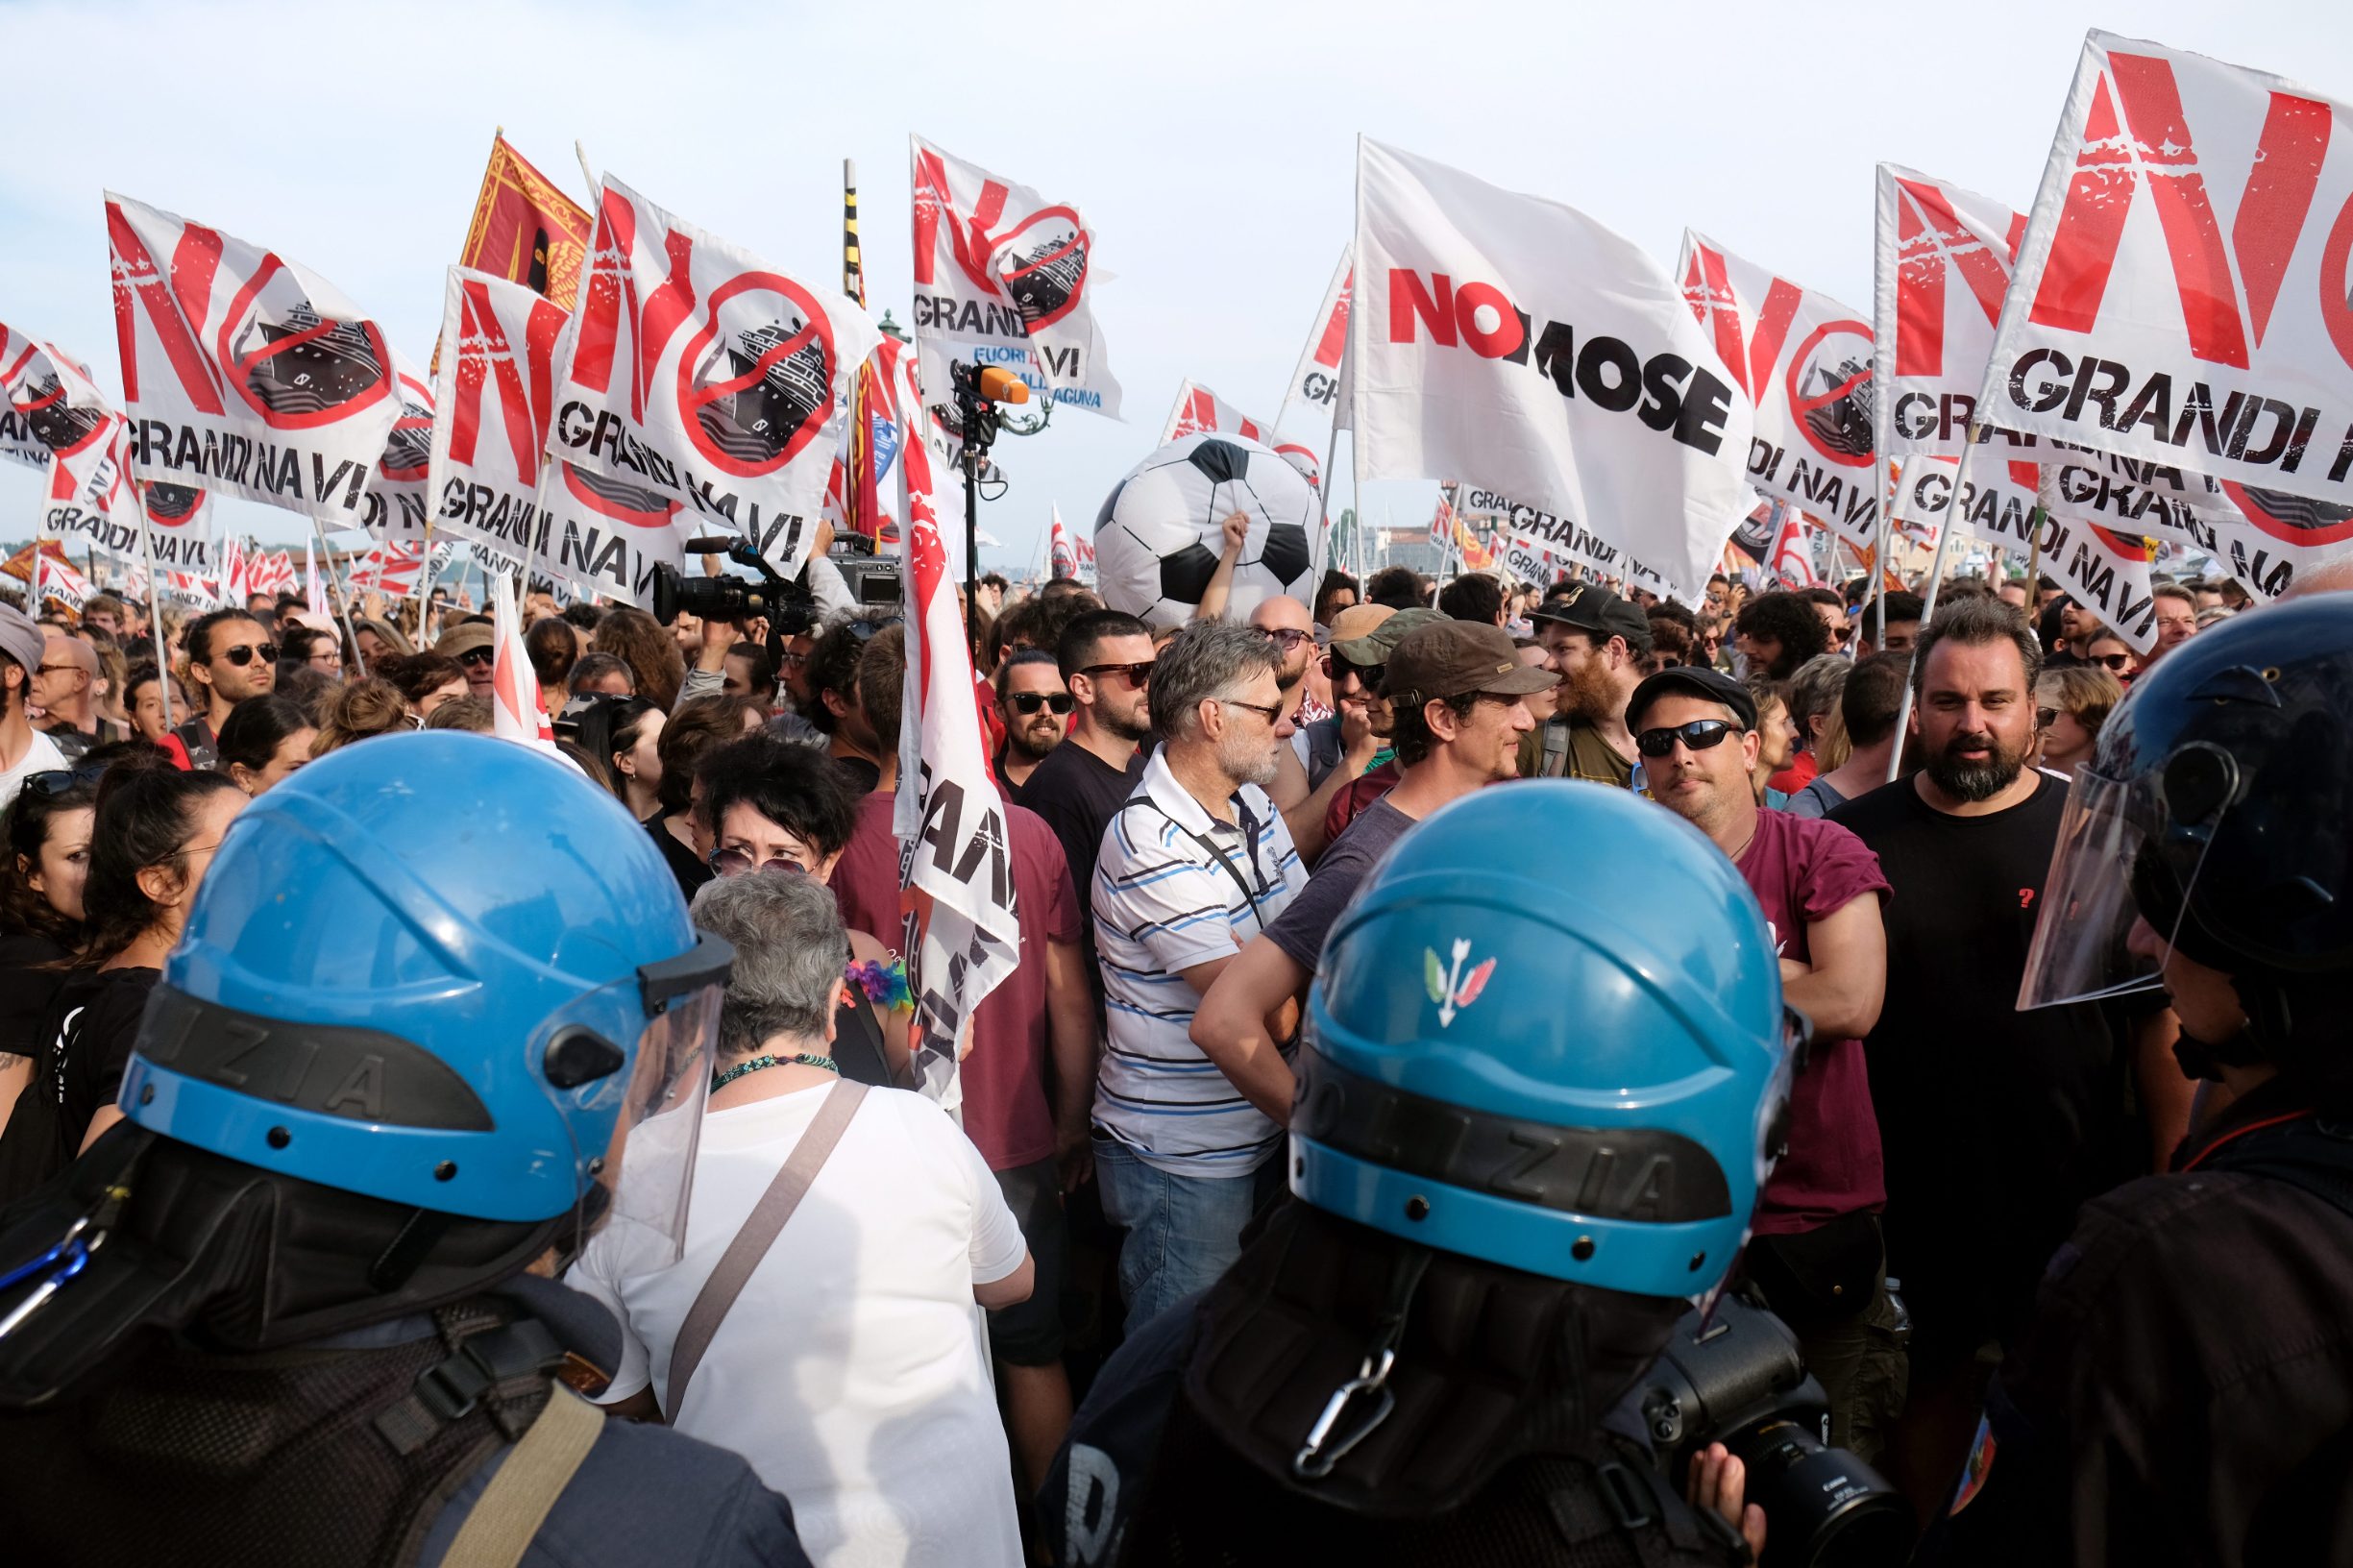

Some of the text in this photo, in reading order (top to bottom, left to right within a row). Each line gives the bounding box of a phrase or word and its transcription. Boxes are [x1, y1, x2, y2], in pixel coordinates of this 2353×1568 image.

[915, 293, 1079, 378] GRAND VI
[974, 347, 1026, 364] FUORI
[1053, 387, 1101, 408] AGUNA
[2008, 348, 2321, 474] GRANDI
[254, 441, 368, 511] NAVI
[558, 401, 803, 563] GRANDI NAVI
[1786, 456, 1876, 535] NAVI
[48, 507, 208, 567] GRANDI NAVI
[439, 476, 655, 600] GRANDI NAV
[2068, 541, 2156, 639] NAVI
